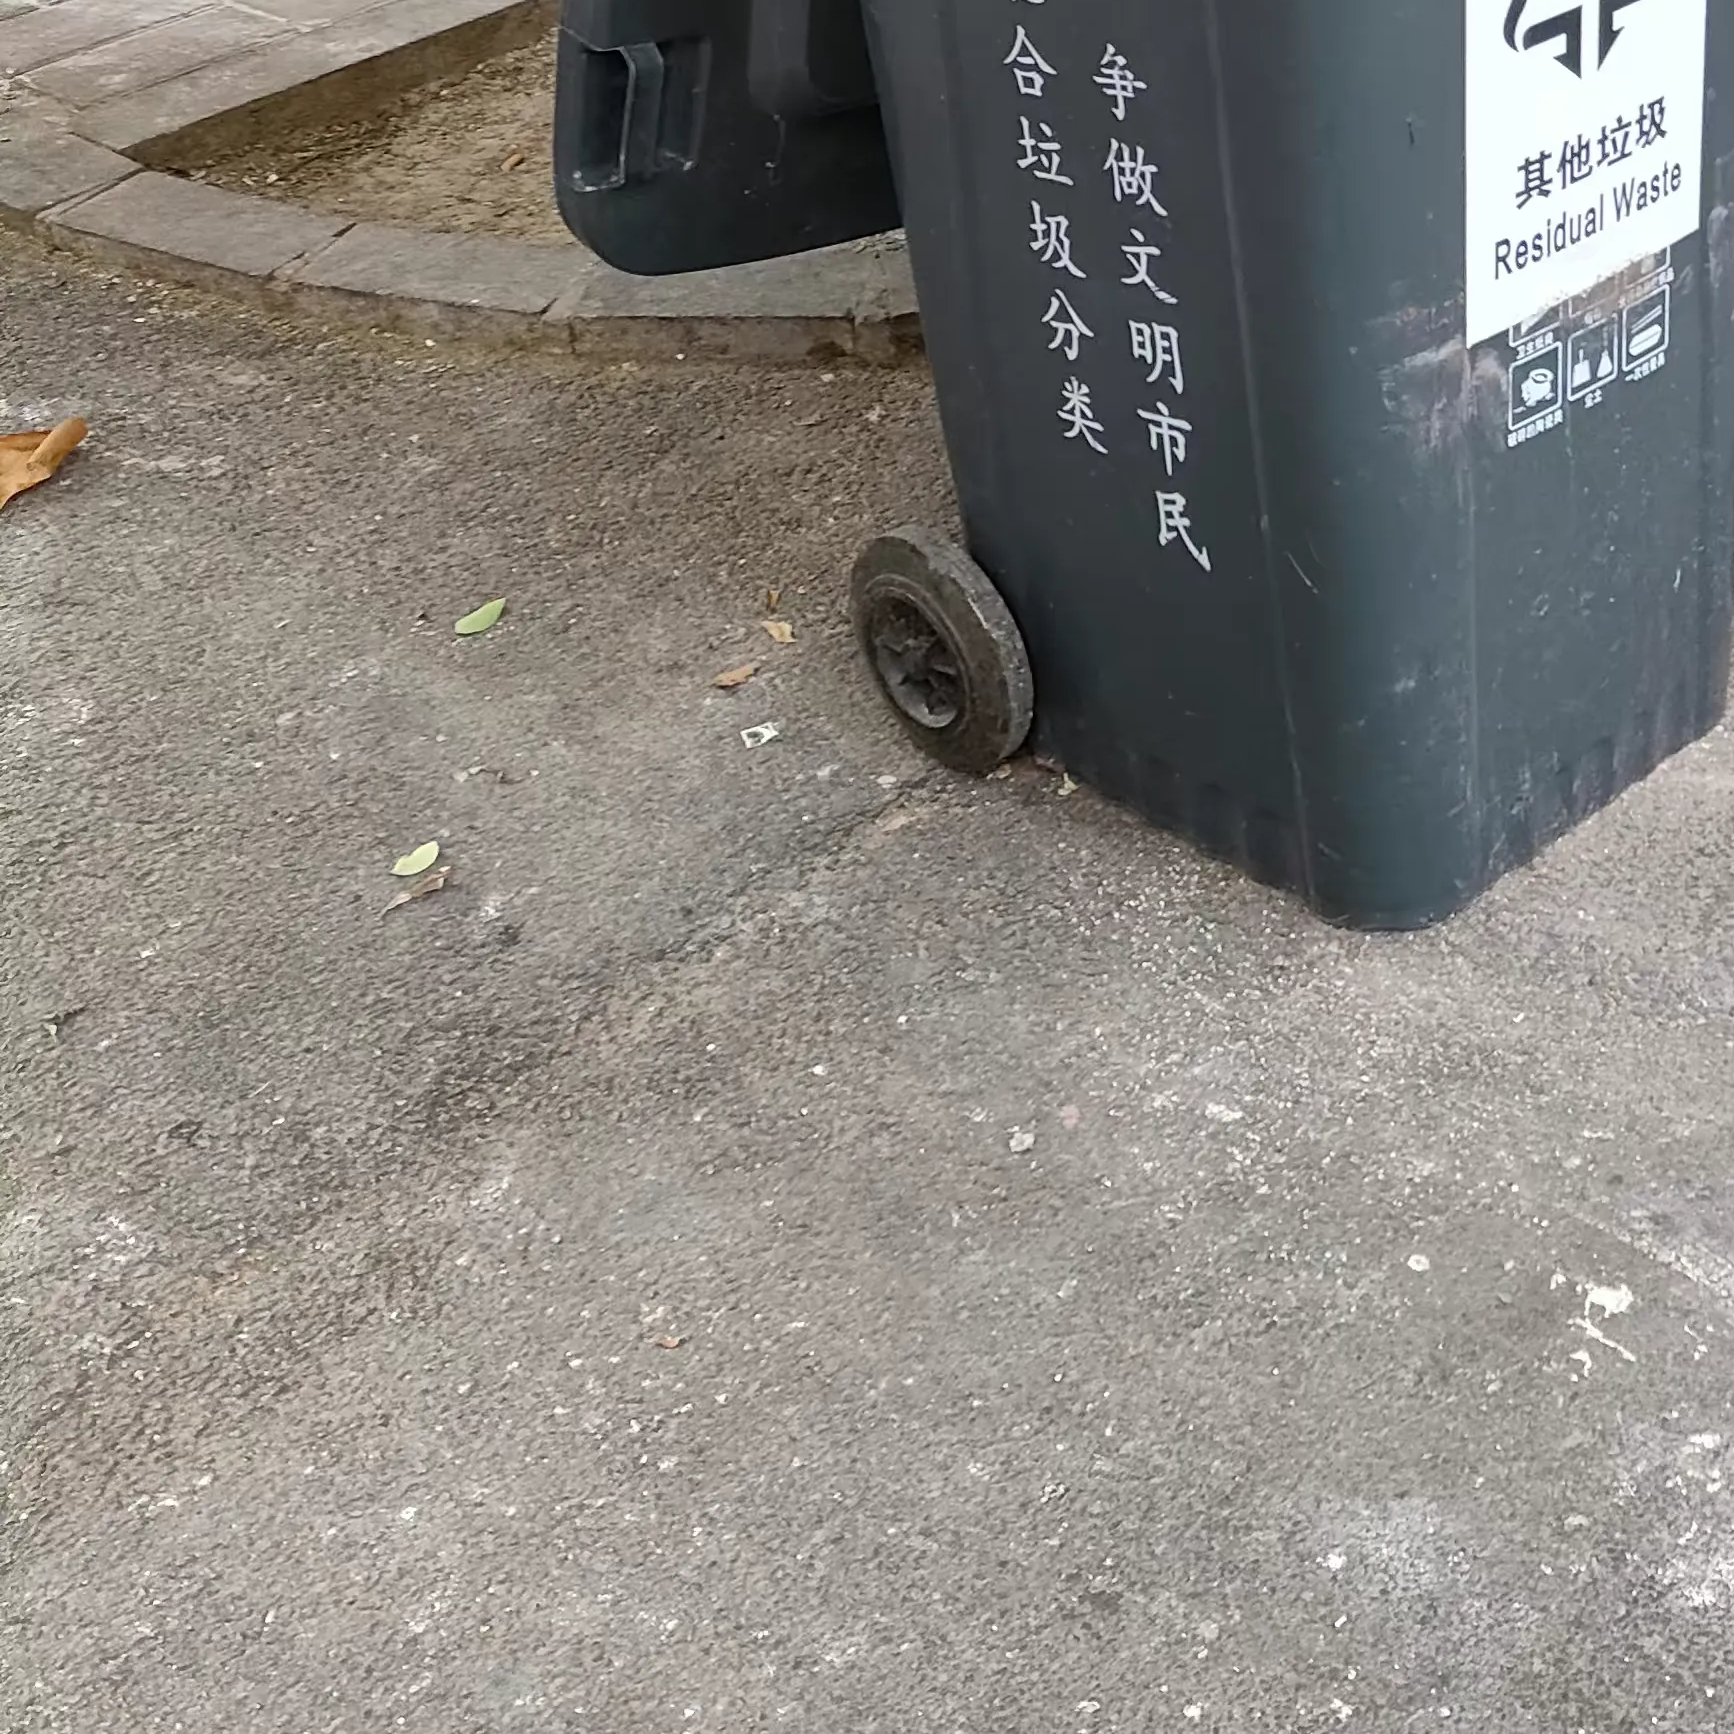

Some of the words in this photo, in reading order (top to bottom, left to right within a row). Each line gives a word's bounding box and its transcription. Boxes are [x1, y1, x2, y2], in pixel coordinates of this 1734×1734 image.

[1515, 96, 1668, 209] 其他垃圾
[1495, 193, 1604, 280] Residual
[1613, 163, 1682, 222] Waste
[1093, 43, 1211, 571] 争做文明市民
